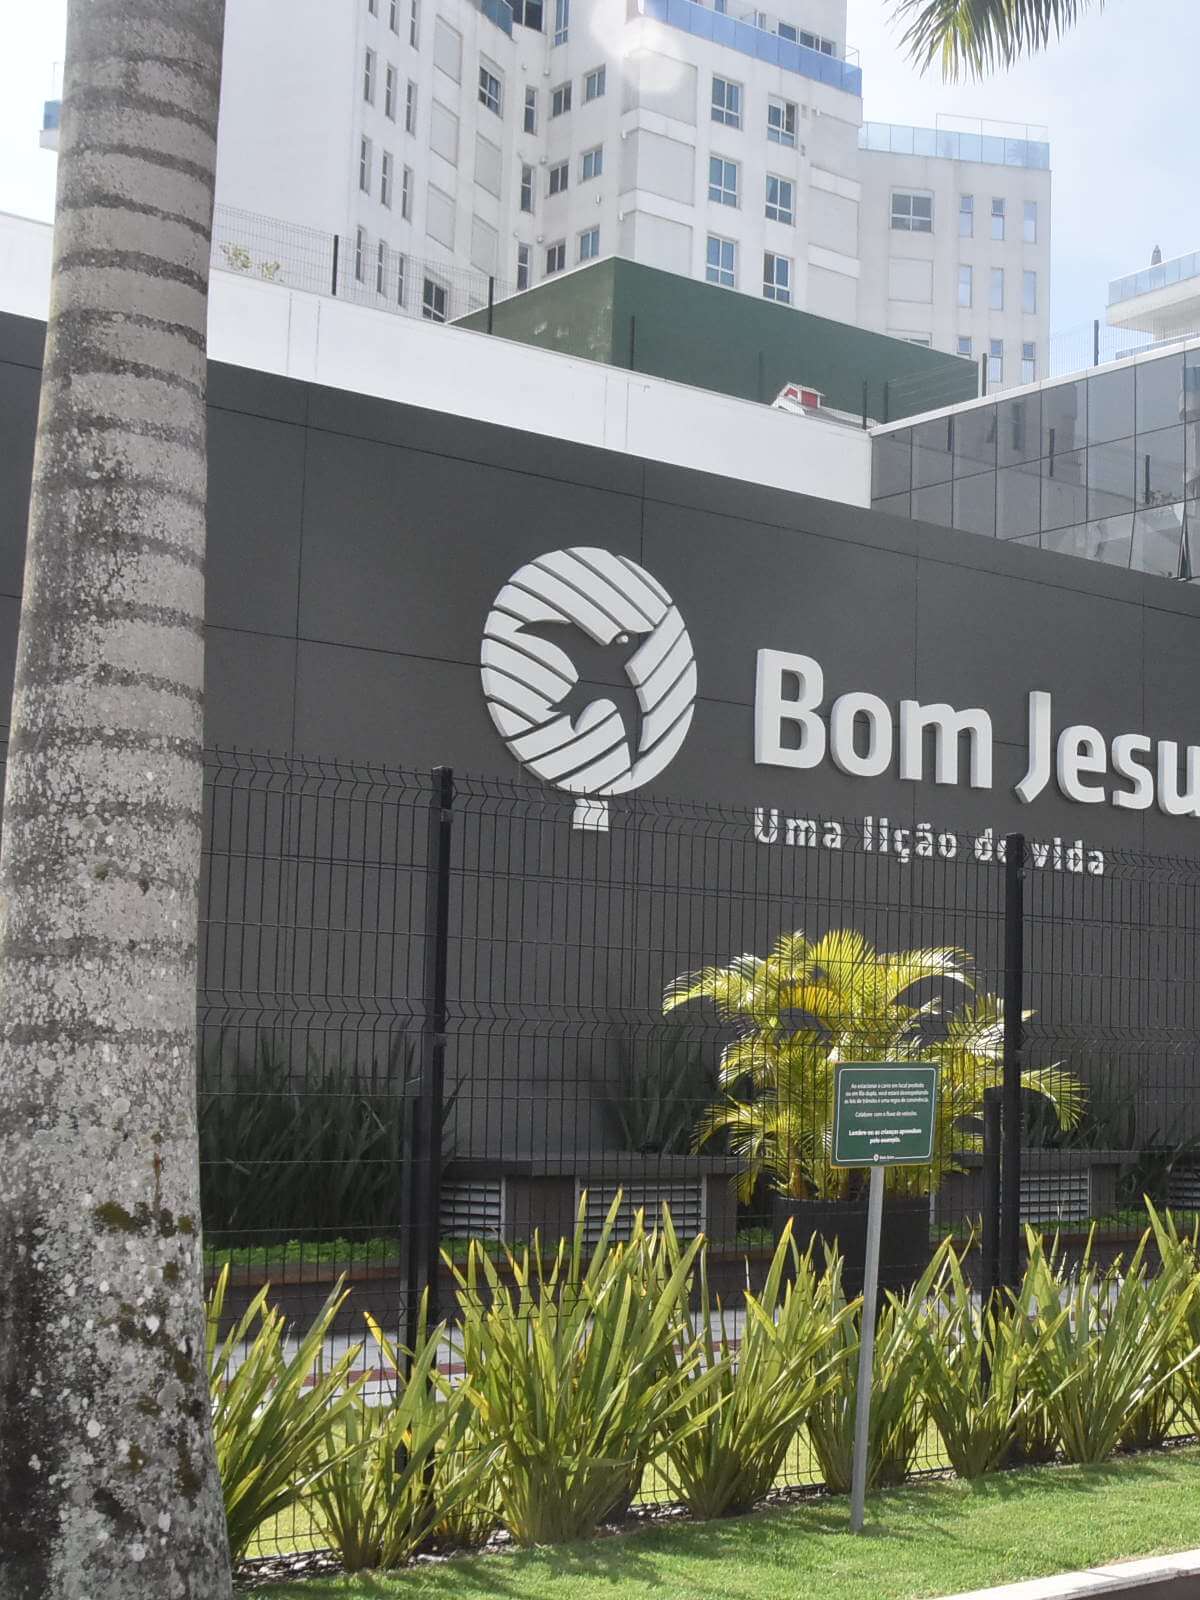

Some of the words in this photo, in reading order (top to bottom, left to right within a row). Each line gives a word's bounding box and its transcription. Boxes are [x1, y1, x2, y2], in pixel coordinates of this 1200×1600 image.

[754, 648, 992, 789] Bom
[754, 807, 842, 849] Uma
[863, 816, 957, 863] lição
[1031, 837, 1104, 875] vida
